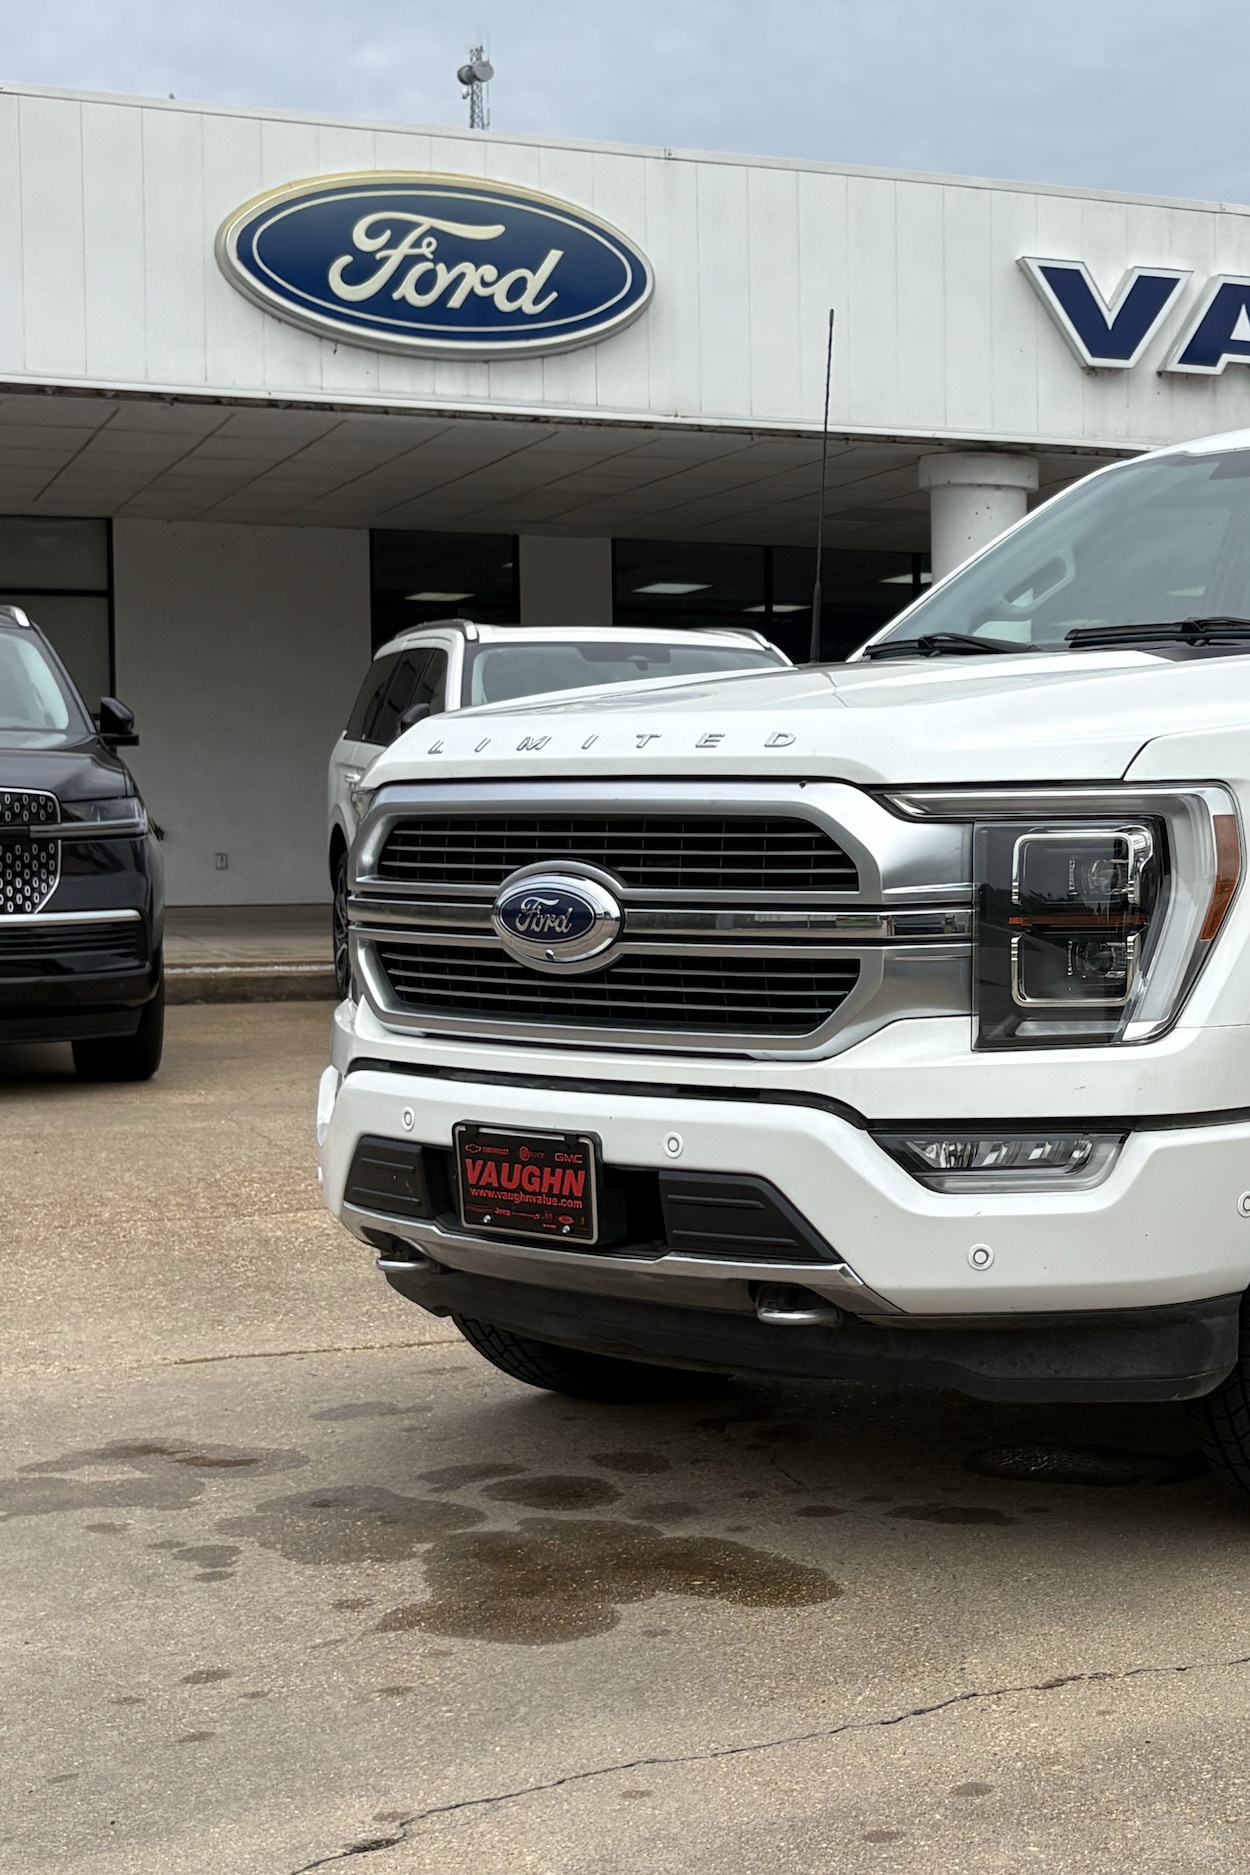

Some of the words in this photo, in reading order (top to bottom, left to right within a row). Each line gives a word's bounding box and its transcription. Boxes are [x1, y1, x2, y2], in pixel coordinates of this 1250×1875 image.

[328, 211, 565, 315] Ford
[426, 730, 798, 755] LIMITED
[515, 896, 573, 934] Ford
[554, 1153, 583, 1164] GMC
[465, 1158, 586, 1197] VAUGHN
[470, 1188, 583, 1209] www.vaughnvalue.com
